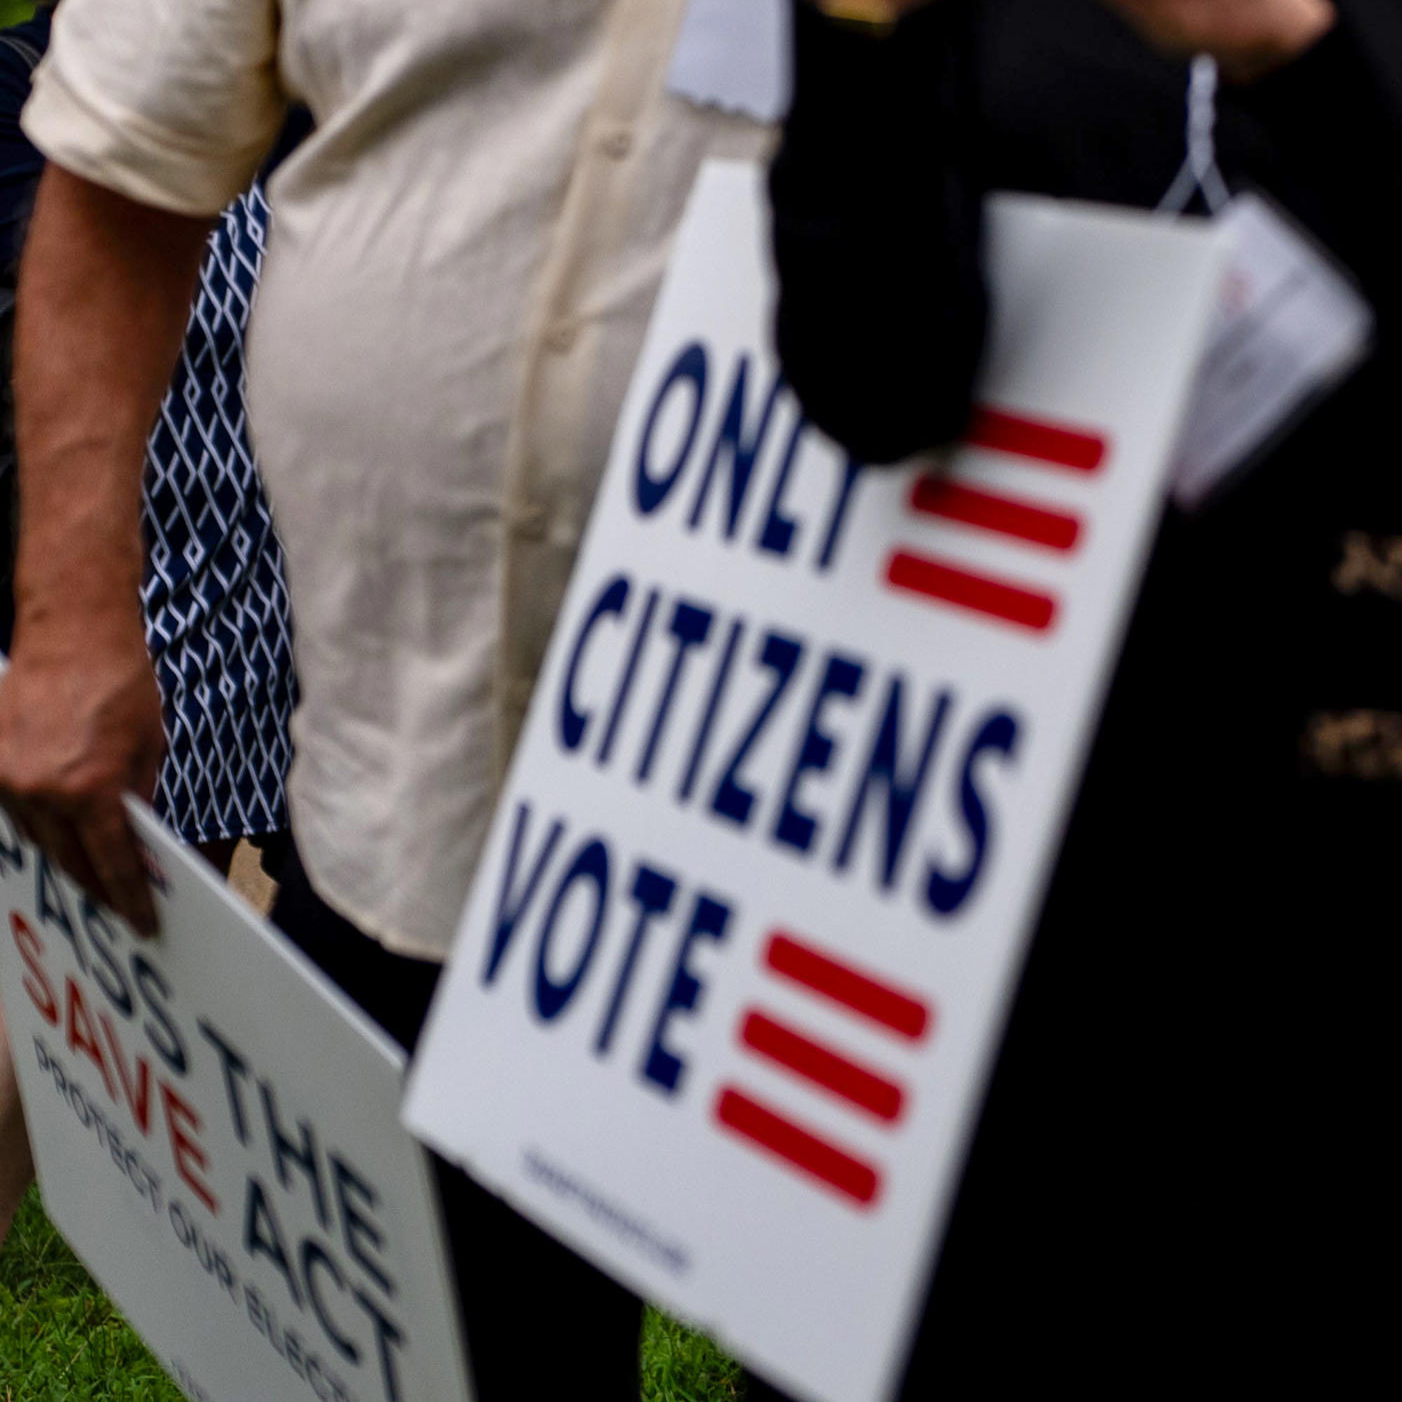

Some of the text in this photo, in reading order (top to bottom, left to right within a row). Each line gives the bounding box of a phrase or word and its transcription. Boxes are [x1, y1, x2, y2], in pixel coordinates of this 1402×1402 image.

[553, 574, 1024, 922] CITIZENS
[478, 801, 736, 1100] VOTE
[8, 909, 407, 1402] SAVE ACT
[32, 1035, 162, 1214] PROTECT
[168, 1200, 240, 1306] OUR
[196, 1014, 396, 1298] THE
